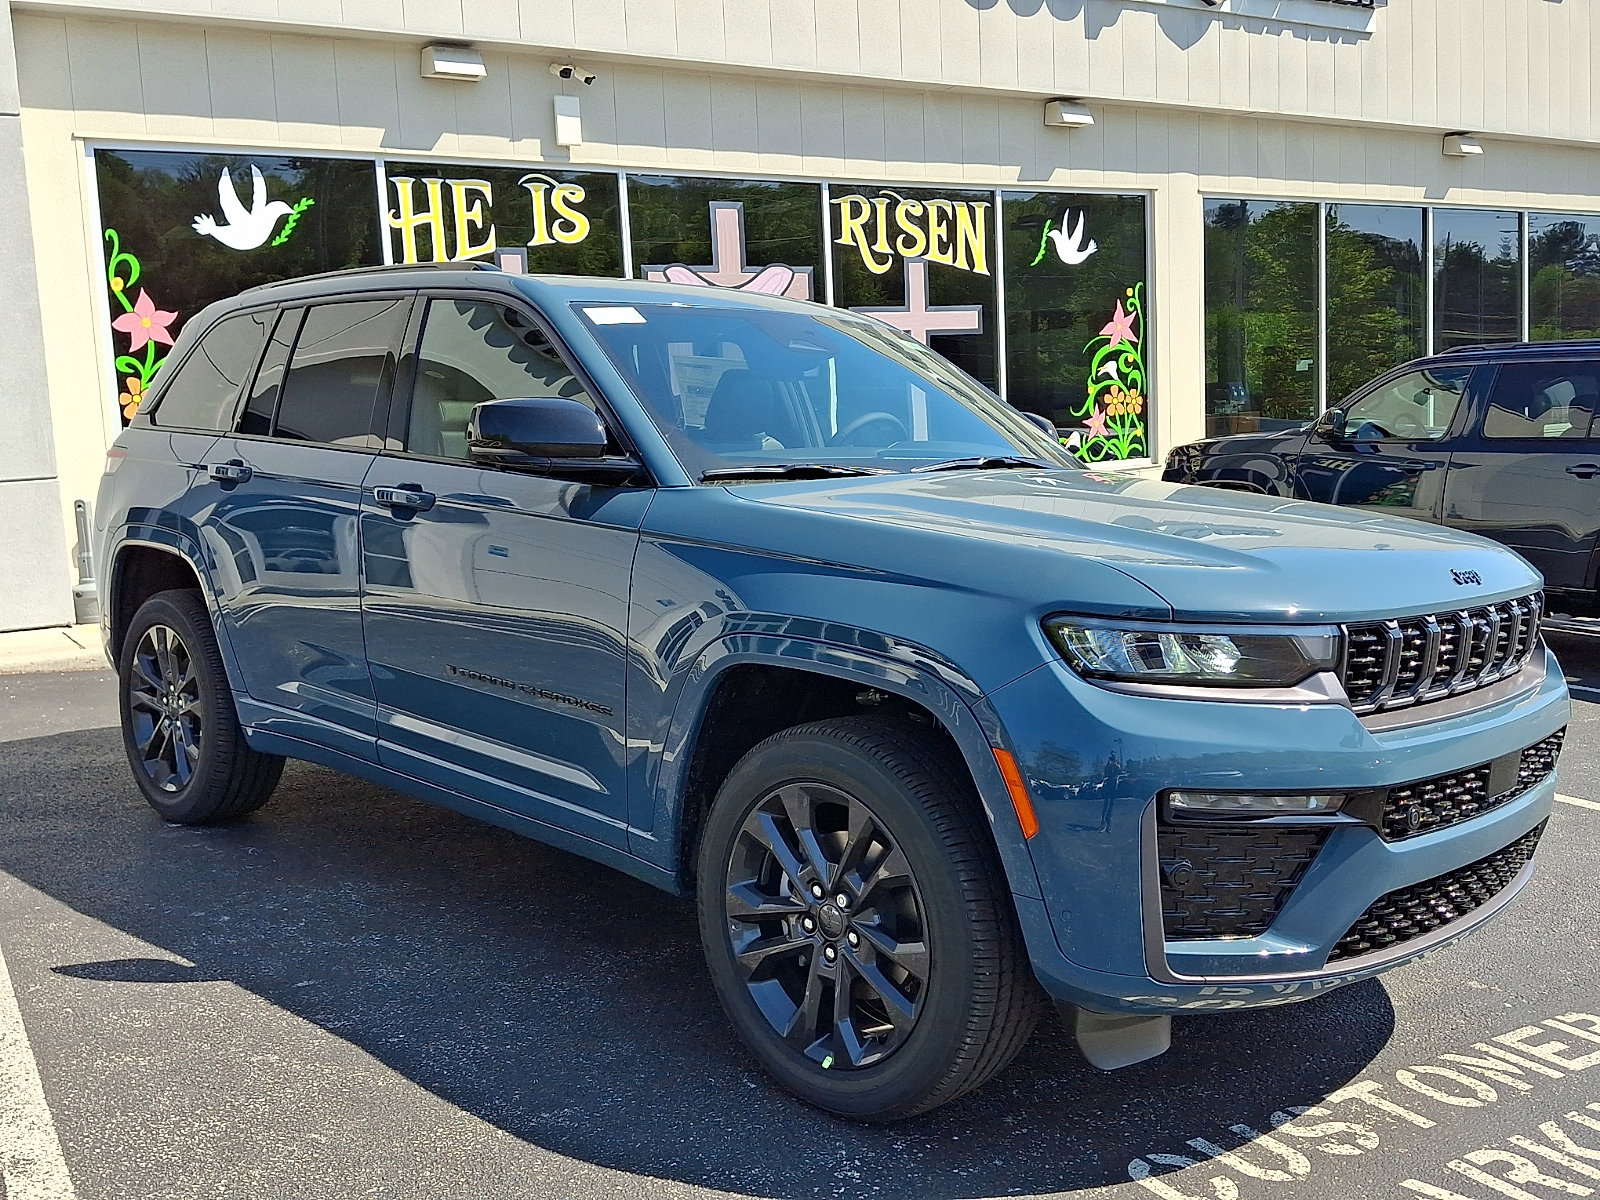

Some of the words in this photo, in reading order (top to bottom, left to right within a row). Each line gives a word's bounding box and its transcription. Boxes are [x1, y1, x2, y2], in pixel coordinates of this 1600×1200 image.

[388, 176, 497, 264] HE
[518, 173, 591, 246] IS
[830, 190, 992, 276] RISEN
[1449, 568, 1482, 586] Jeep
